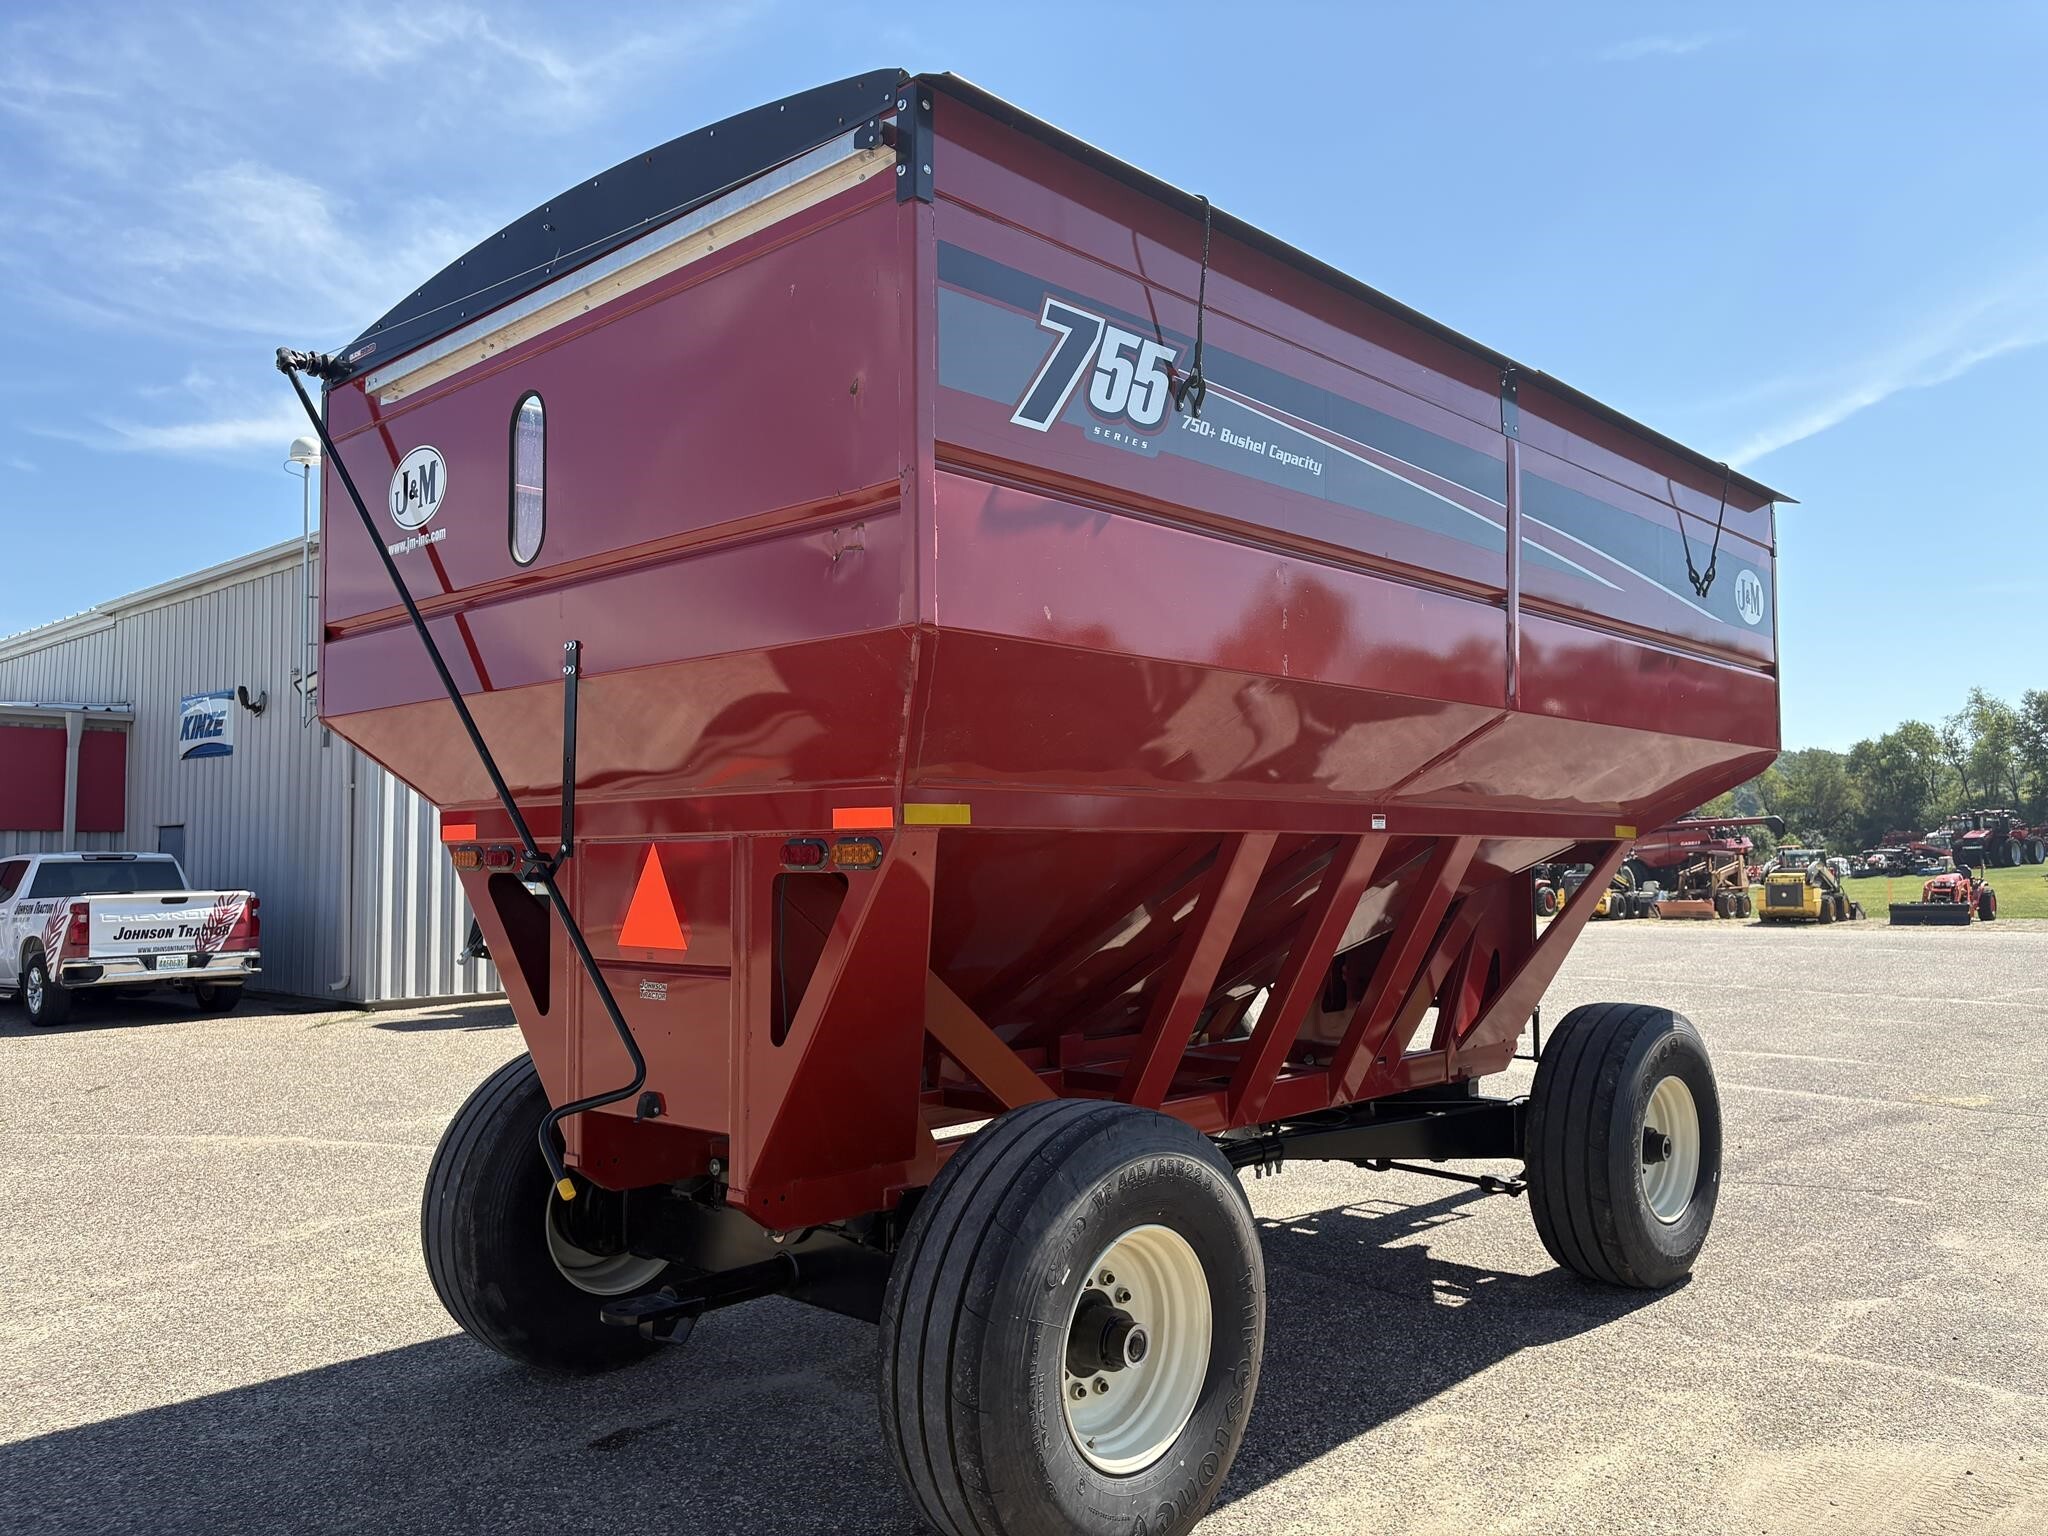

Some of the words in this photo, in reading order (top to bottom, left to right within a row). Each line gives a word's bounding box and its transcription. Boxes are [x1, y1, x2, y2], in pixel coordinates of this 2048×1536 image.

[1010, 297, 1177, 433] 755
[1093, 426, 1149, 449] SERIES
[1180, 414, 1216, 438] 750+
[1220, 427, 1267, 456] Bushel
[1268, 444, 1323, 476] Capacity
[395, 460, 437, 515] J&M
[388, 528, 447, 555] www.jm-inc.com
[1737, 579, 1760, 616] J&M
[180, 711, 226, 741] KINZE
[113, 926, 175, 940] JOHNSON
[640, 979, 667, 990] JOHNSON
[640, 989, 666, 1000] TRACTOR
